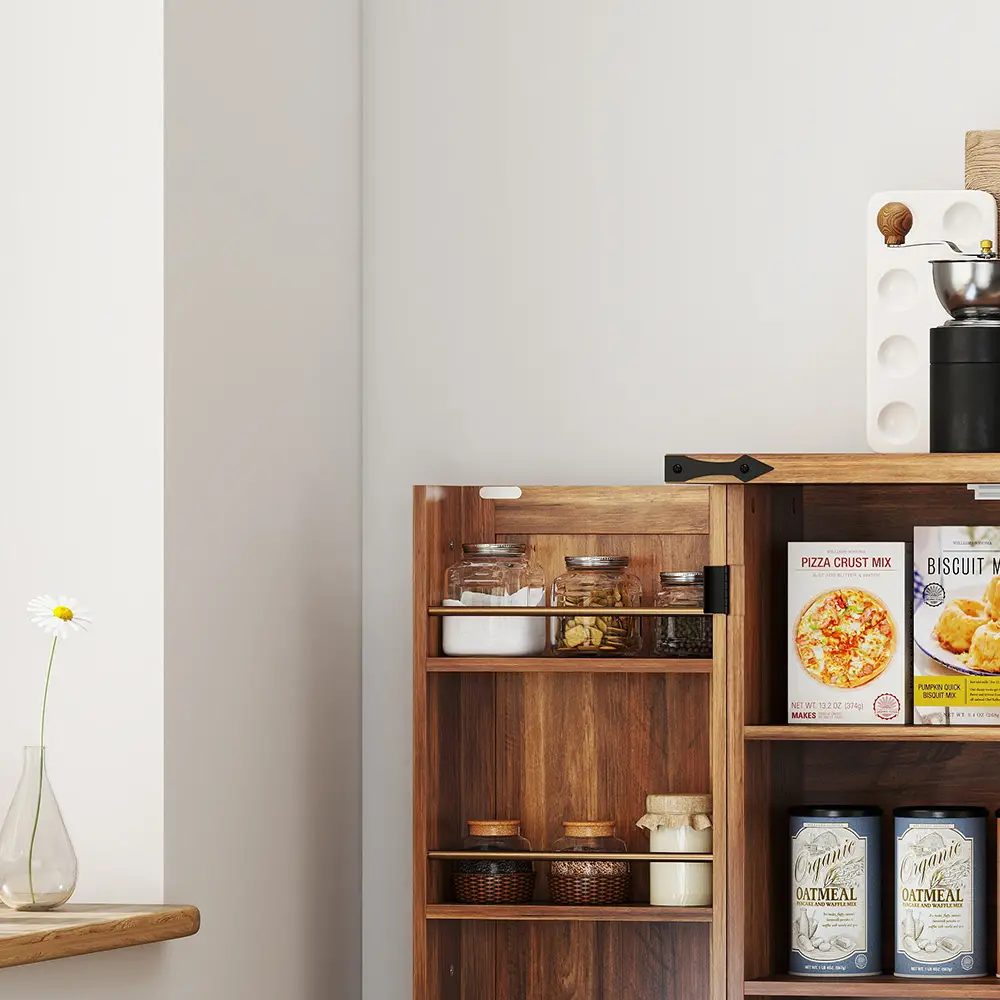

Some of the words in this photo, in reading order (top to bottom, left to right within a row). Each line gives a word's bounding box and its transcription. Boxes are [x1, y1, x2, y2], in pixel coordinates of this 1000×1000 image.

[801, 557, 831, 568] PIZZA
[834, 557, 869, 568] CRUST
[872, 557, 892, 568] MIX
[928, 558, 984, 575] BISCUIT
[944, 684, 961, 692] QUICK
[794, 838, 856, 885] Organic
[900, 840, 962, 886] Organic
[796, 886, 858, 901] OATMEAL
[902, 888, 964, 902] OATMEAL
